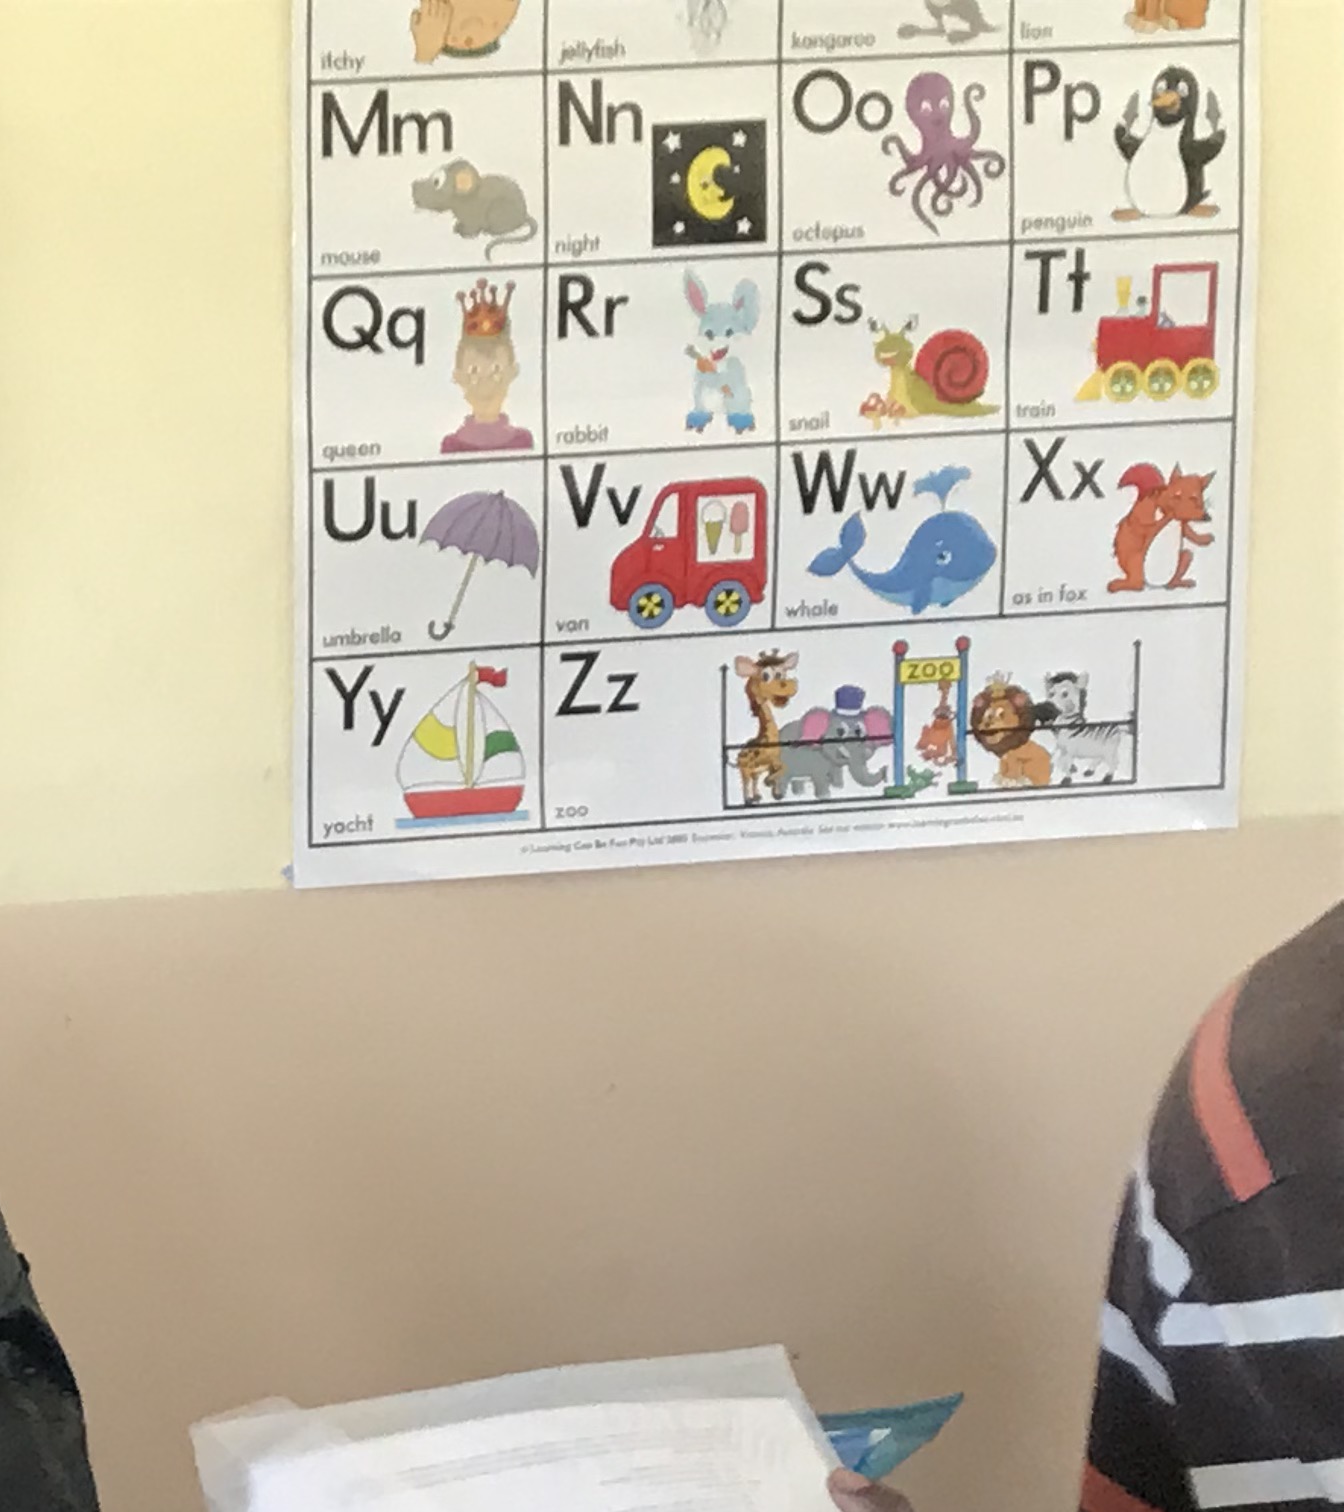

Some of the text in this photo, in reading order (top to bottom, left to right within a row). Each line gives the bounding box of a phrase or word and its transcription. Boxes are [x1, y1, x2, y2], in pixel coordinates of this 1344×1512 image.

[791, 31, 876, 52] kangaroo
[1020, 21, 1053, 40] lion
[321, 49, 365, 73] itchy
[793, 68, 893, 134] Oo
[1024, 59, 1101, 141] Pp
[321, 88, 453, 158] Mm
[558, 78, 643, 146] Nn
[792, 222, 866, 243] octopus
[1021, 213, 1093, 234] penguin
[555, 234, 601, 257] night
[321, 249, 381, 267] mouse
[1024, 247, 1091, 315] Tt
[792, 260, 863, 326] Ss
[557, 273, 629, 341] Rr
[322, 284, 425, 366] Qq
[1016, 401, 1056, 418] train
[789, 411, 831, 432] snail
[556, 424, 609, 445] rabbit
[322, 441, 382, 462] queen
[1019, 436, 1105, 503] Xx
[790, 448, 907, 515] Ww
[559, 462, 643, 530] Vv
[323, 475, 417, 542] Uu
[1013, 584, 1088, 605] as in fox
[785, 599, 839, 618] whale
[322, 625, 402, 648] umbrella
[556, 618, 589, 633] van
[907, 661, 955, 681] ZOO
[555, 651, 639, 717] Zz
[324, 664, 406, 747] Yy
[555, 805, 589, 819] zoo
[323, 816, 374, 838] yacht
